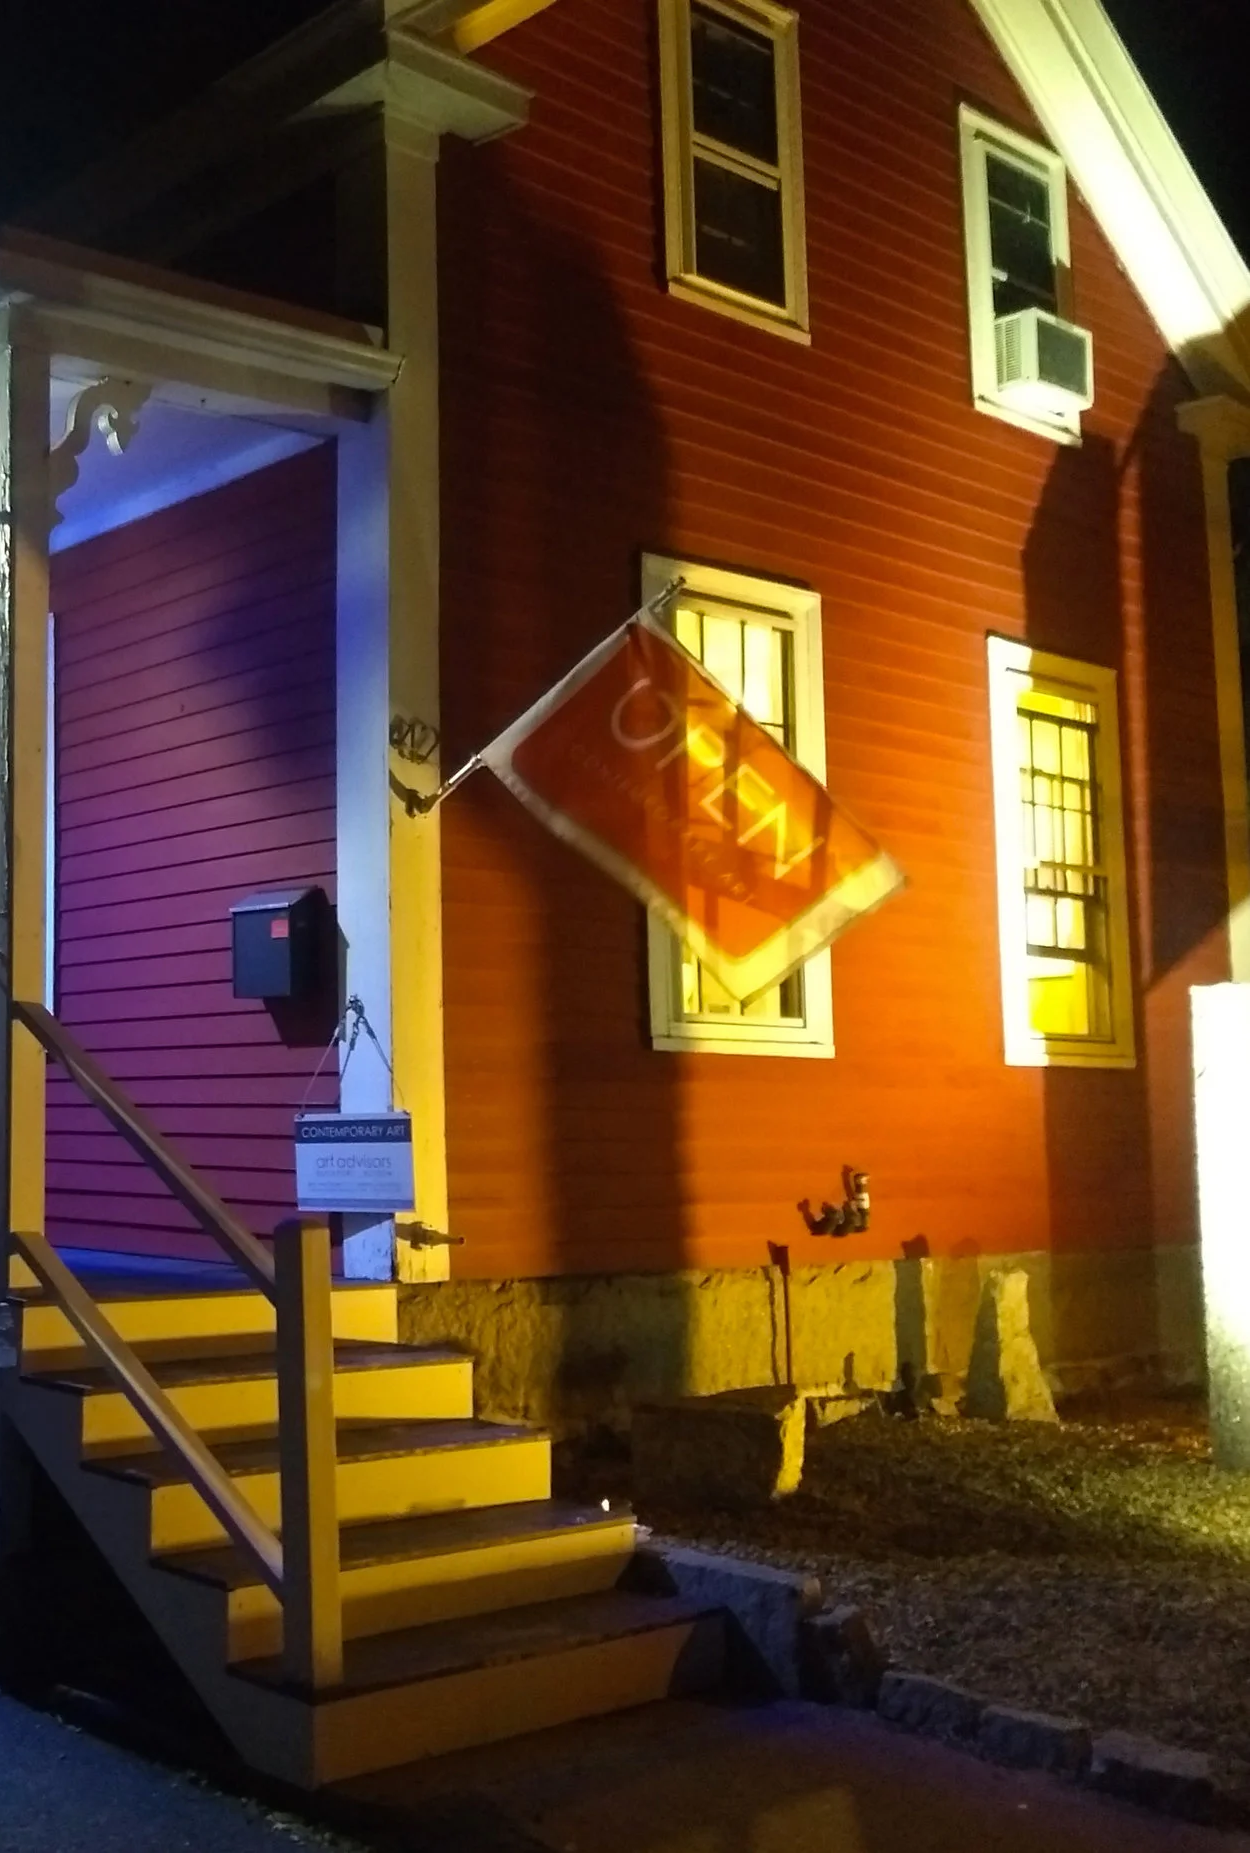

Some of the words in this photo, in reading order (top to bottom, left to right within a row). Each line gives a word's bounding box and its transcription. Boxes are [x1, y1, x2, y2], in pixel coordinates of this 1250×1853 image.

[611, 677, 826, 880] OPEN
[301, 1126, 383, 1138] CONTEMPORARY
[386, 1125, 405, 1137] ART
[316, 1154, 334, 1169] art
